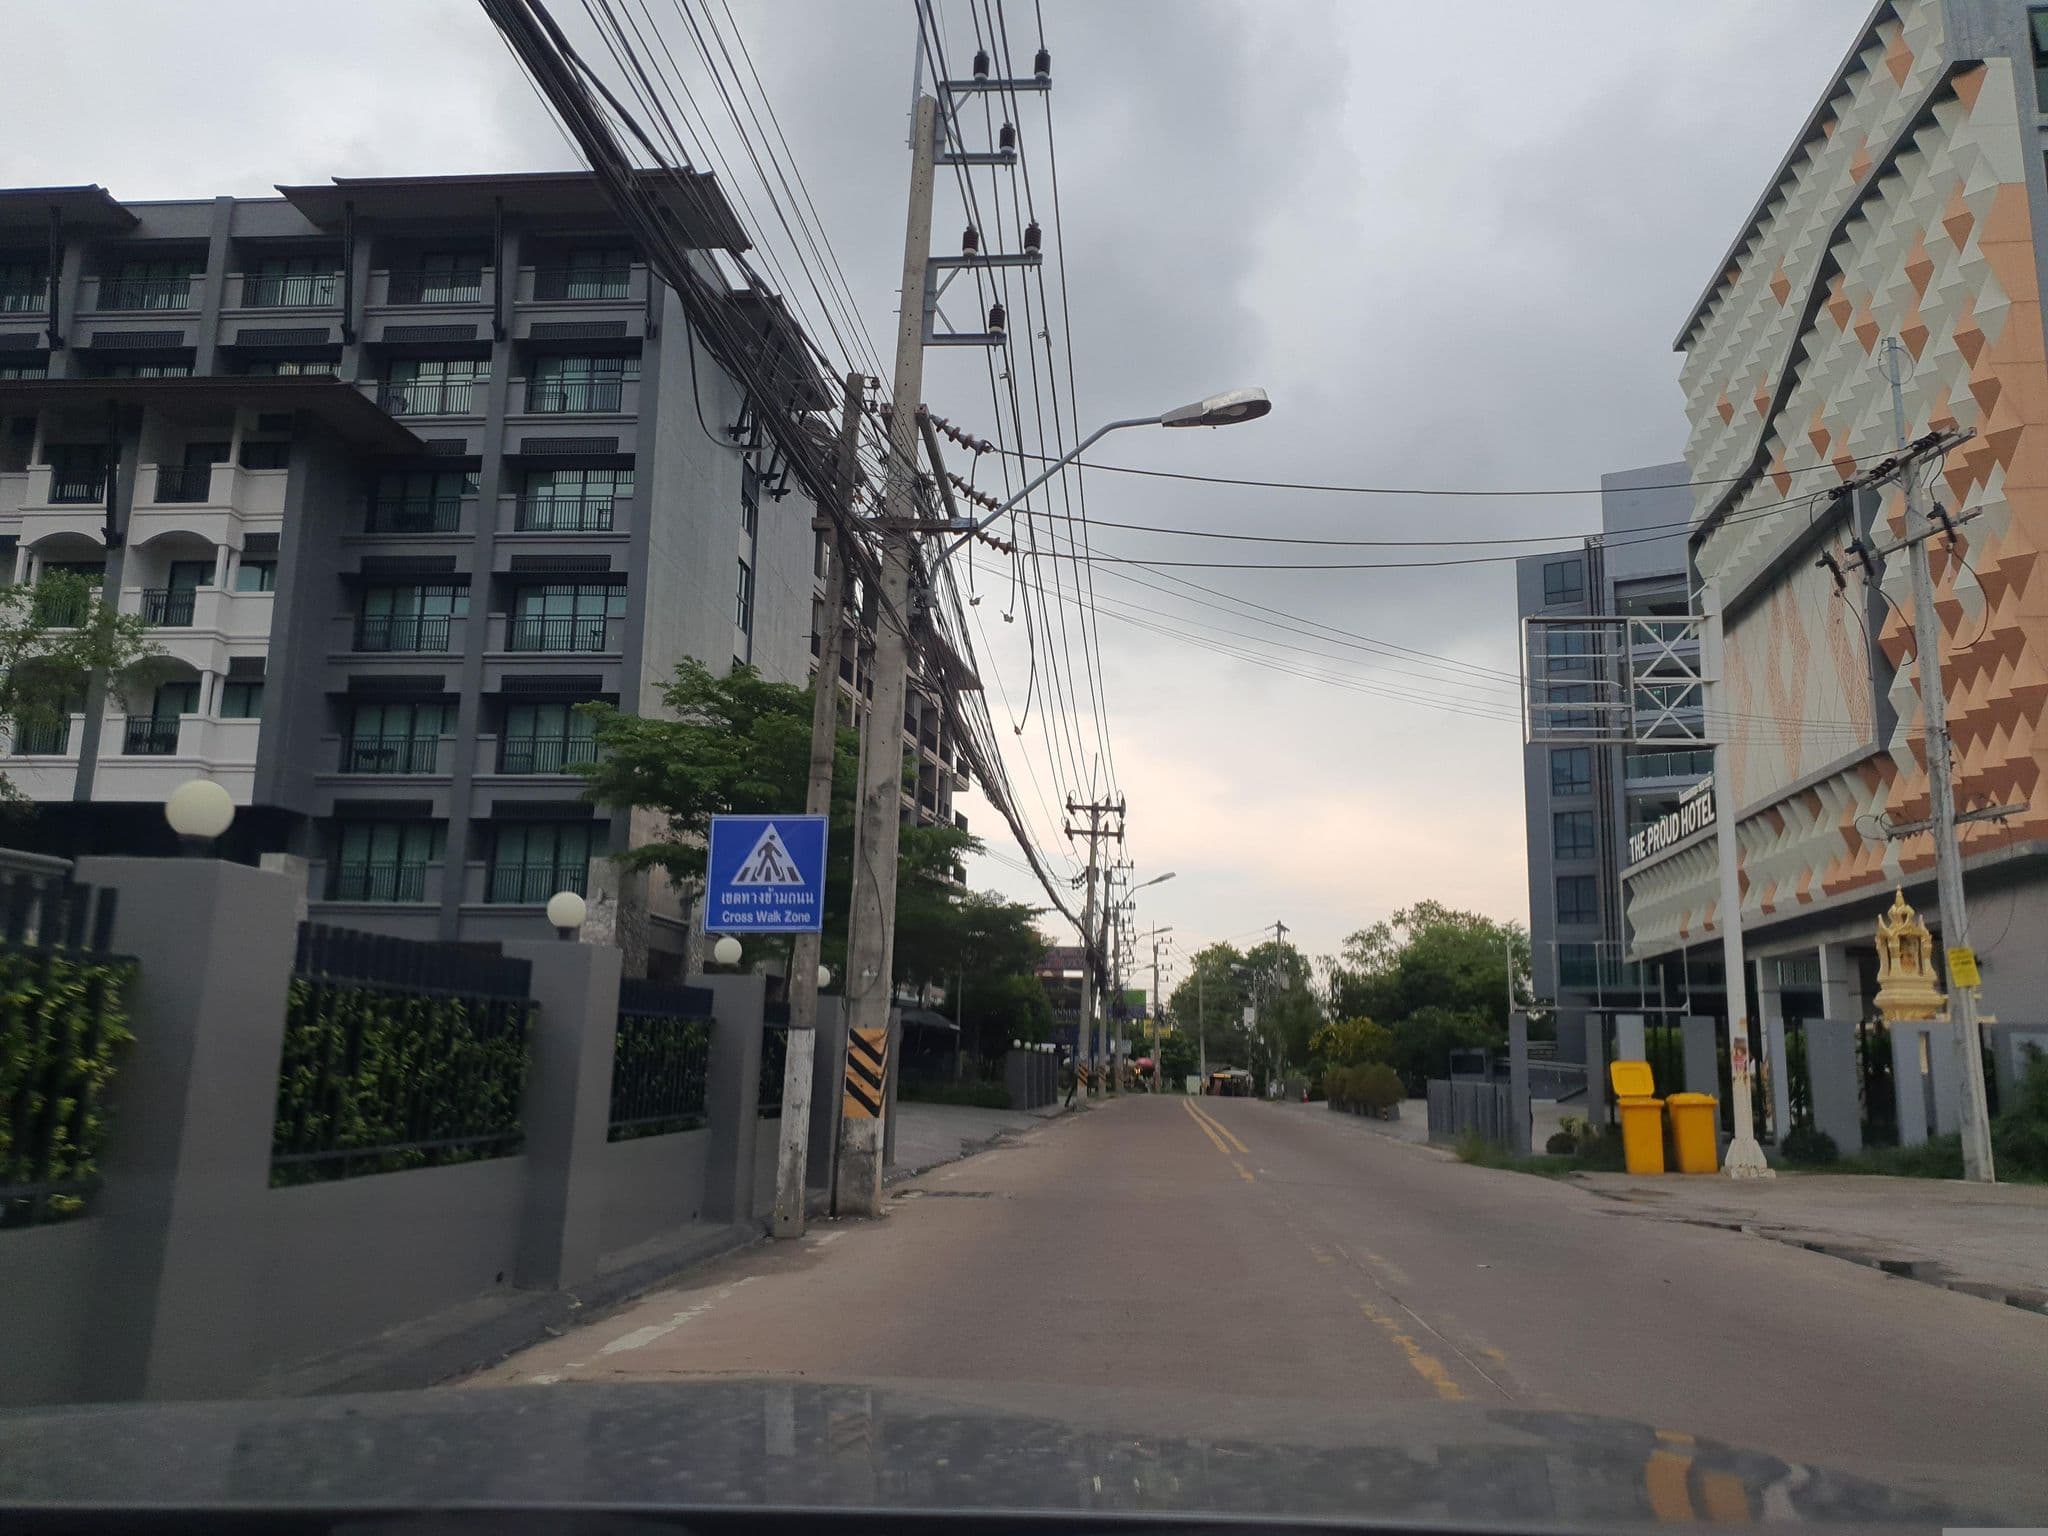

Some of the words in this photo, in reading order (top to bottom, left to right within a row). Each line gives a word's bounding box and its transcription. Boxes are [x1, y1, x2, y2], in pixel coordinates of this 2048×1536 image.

[1629, 830, 1646, 863] THE
[1647, 812, 1679, 855] PROUD
[1681, 791, 1715, 837] HOTEL
[721, 886, 814, 904] เขตทางข้ามถนน
[722, 910, 754, 923] Cross
[756, 910, 781, 923] Walk
[784, 910, 810, 923] Zone
